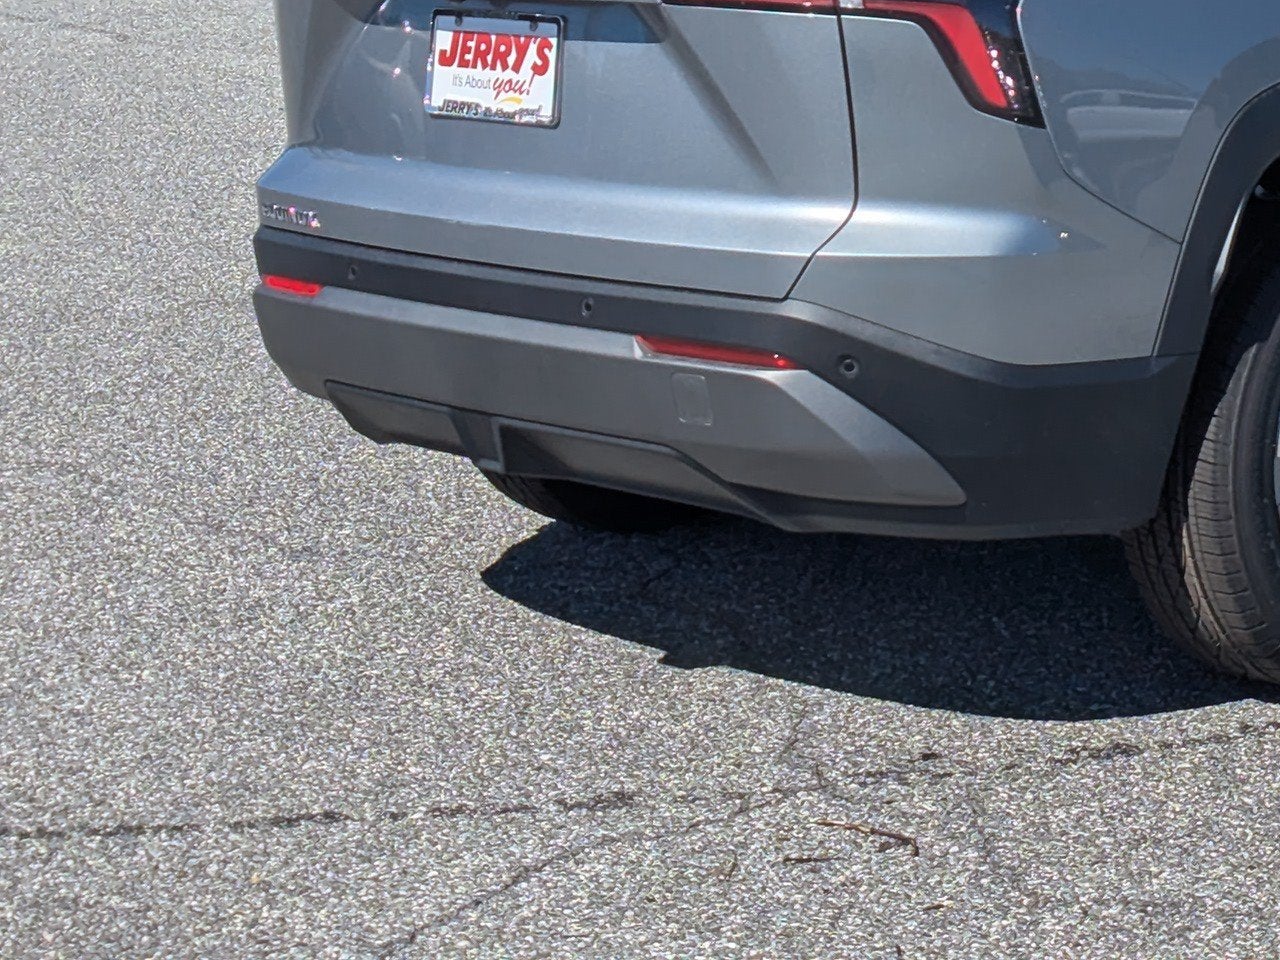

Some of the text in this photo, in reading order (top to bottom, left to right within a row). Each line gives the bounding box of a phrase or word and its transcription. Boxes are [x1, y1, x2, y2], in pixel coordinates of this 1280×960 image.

[438, 30, 554, 77] JERRY'S
[464, 74, 491, 89] About
[492, 73, 535, 100] you!
